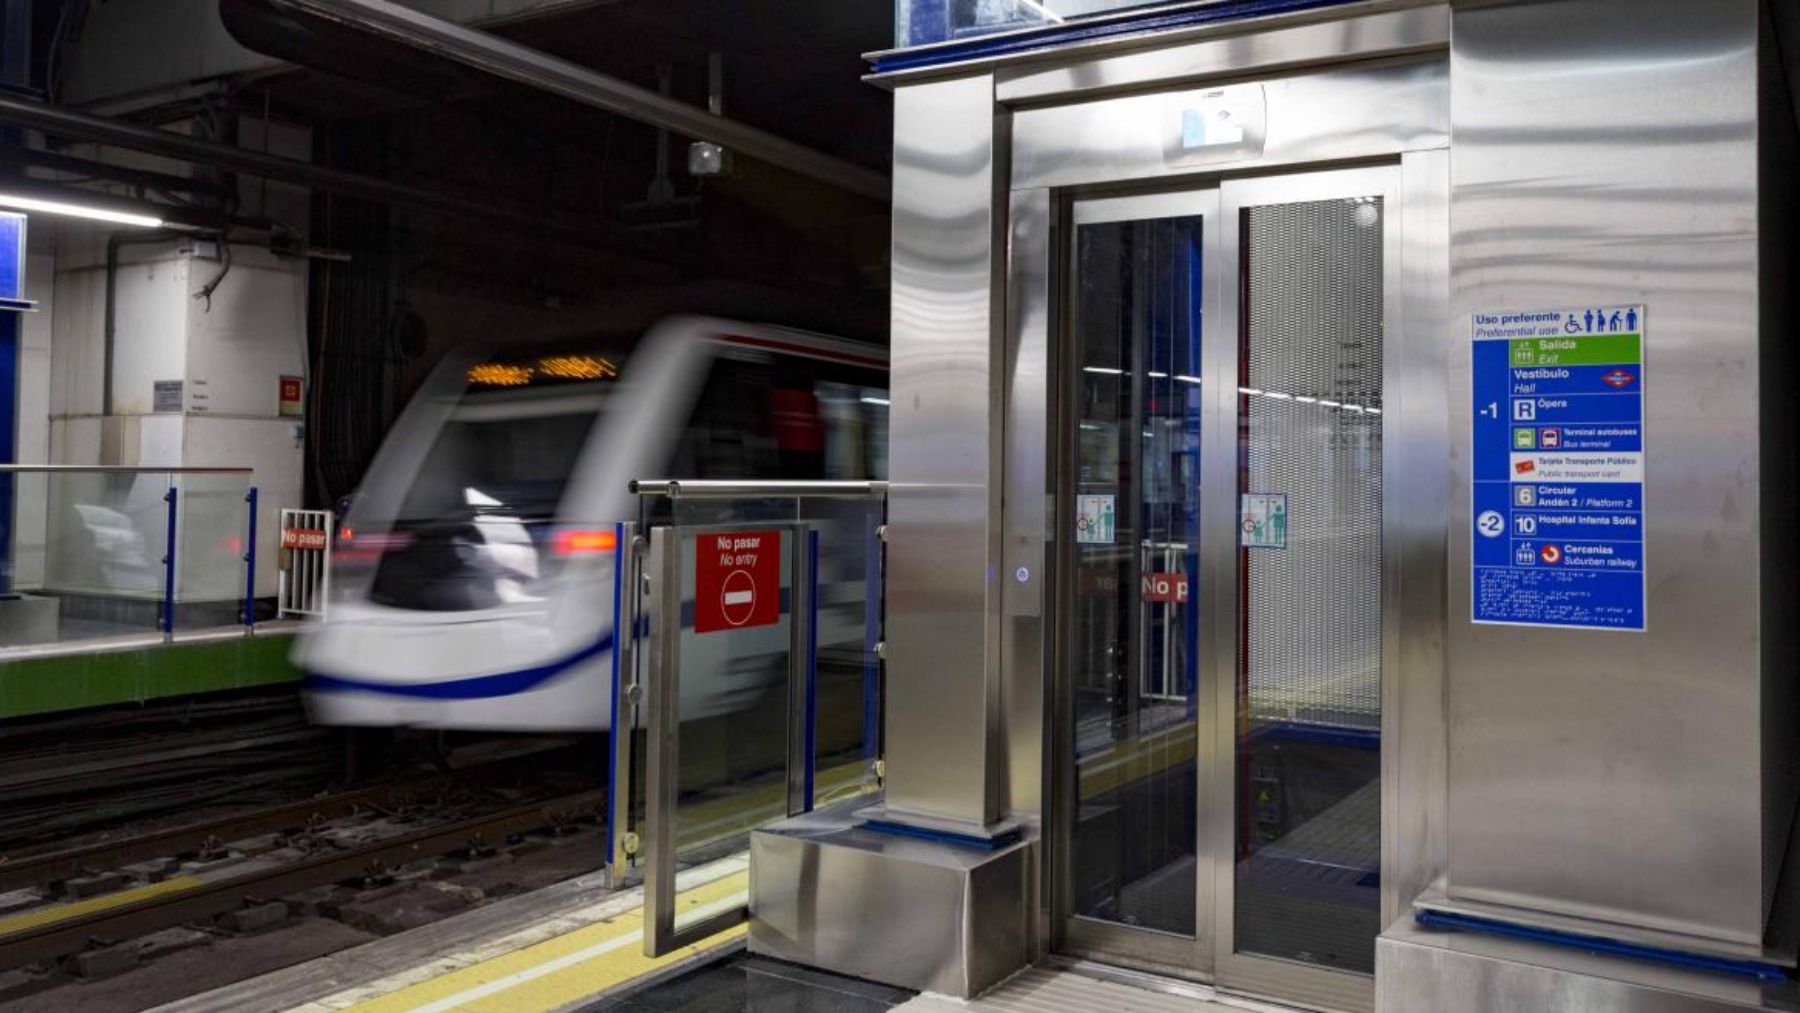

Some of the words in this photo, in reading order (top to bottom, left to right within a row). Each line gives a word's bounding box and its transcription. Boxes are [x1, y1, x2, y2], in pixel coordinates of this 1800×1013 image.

[1476, 315, 1498, 324] Uso
[1501, 312, 1560, 325] preferente
[1476, 327, 1536, 337] Preferential
[1538, 327, 1559, 335] use
[1539, 340, 1576, 350] Salida
[1538, 354, 1559, 364] Exit
[1514, 383, 1536, 393] Hall
[1480, 402, 1498, 419] -1
[1519, 402, 1532, 418] R
[1564, 428, 1595, 436] Terminal
[1597, 428, 1637, 436] autobuses
[1563, 440, 1578, 448] Bus
[1579, 440, 1611, 448] terminal
[1538, 458, 1563, 466] Tarjeta
[1565, 458, 1604, 466] Transporte
[1538, 470, 1563, 478] Public
[1564, 470, 1600, 479] transport
[1602, 470, 1621, 478] card
[1538, 486, 1577, 495] Circular
[1519, 488, 1531, 504] 6
[1538, 497, 1569, 507] Andén
[1571, 498, 1578, 507] 2
[1585, 498, 1624, 507] Platform
[1626, 499, 1633, 507] 2
[1480, 516, 1500, 532] -2
[1516, 517, 1535, 533] 10
[1539, 516, 1576, 525] Hospital
[1578, 516, 1610, 525] Infanta
[282, 529, 296, 543] No
[299, 532, 326, 547] pasar
[717, 536, 732, 550] No
[734, 537, 761, 552] pasar
[720, 553, 734, 566] No
[736, 554, 758, 568] entry
[1564, 557, 1605, 566] Suburban
[1607, 558, 1637, 568] railway
[1142, 576, 1169, 595] No
